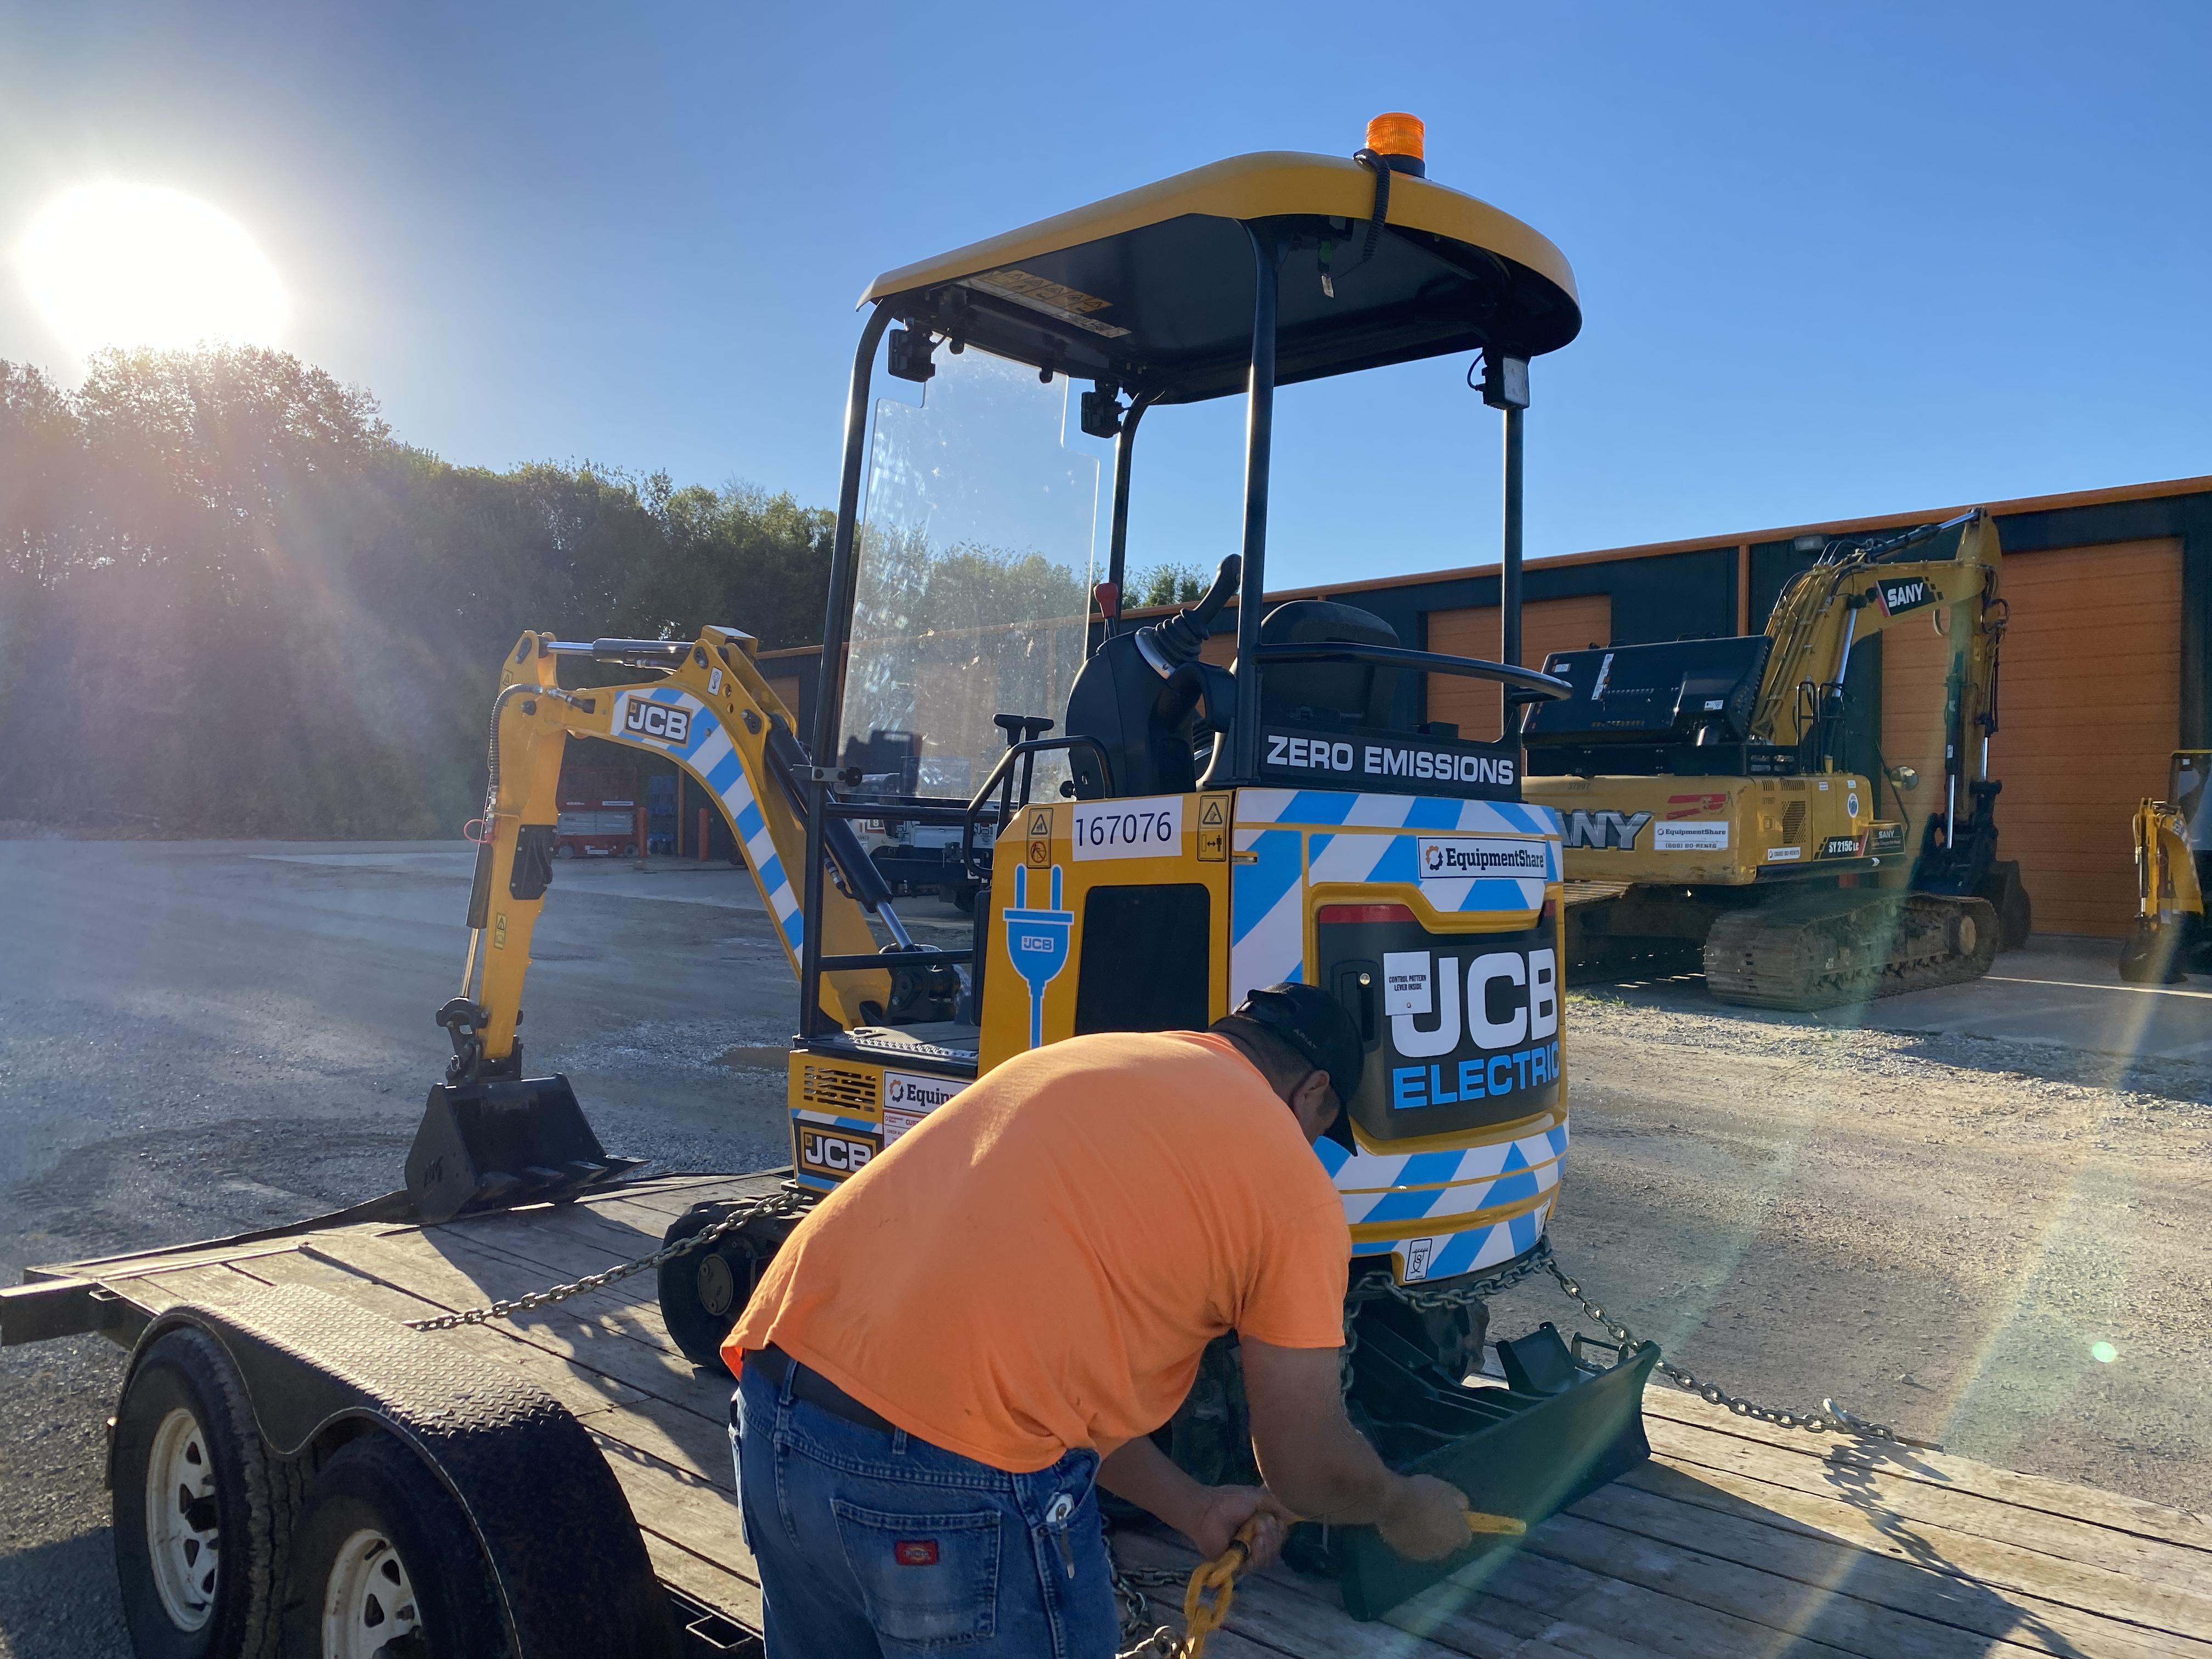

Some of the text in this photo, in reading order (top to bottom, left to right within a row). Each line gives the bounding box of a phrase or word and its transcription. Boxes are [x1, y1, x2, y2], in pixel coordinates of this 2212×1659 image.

[1888, 582, 1923, 607] SANY
[628, 704, 687, 740] JCB
[1267, 735, 1514, 785] ZERO EMISSIONS
[1076, 812, 1171, 846] 167076
[1879, 830, 1894, 838] SANY
[1446, 848, 1544, 871] EquipmentShare
[1024, 938, 1052, 950] JCB
[1391, 948, 1557, 1058] JCB
[1393, 1040, 1560, 1109] ELECTRIC
[907, 1084, 956, 1107] Equip
[805, 1136, 871, 1172] JCB
